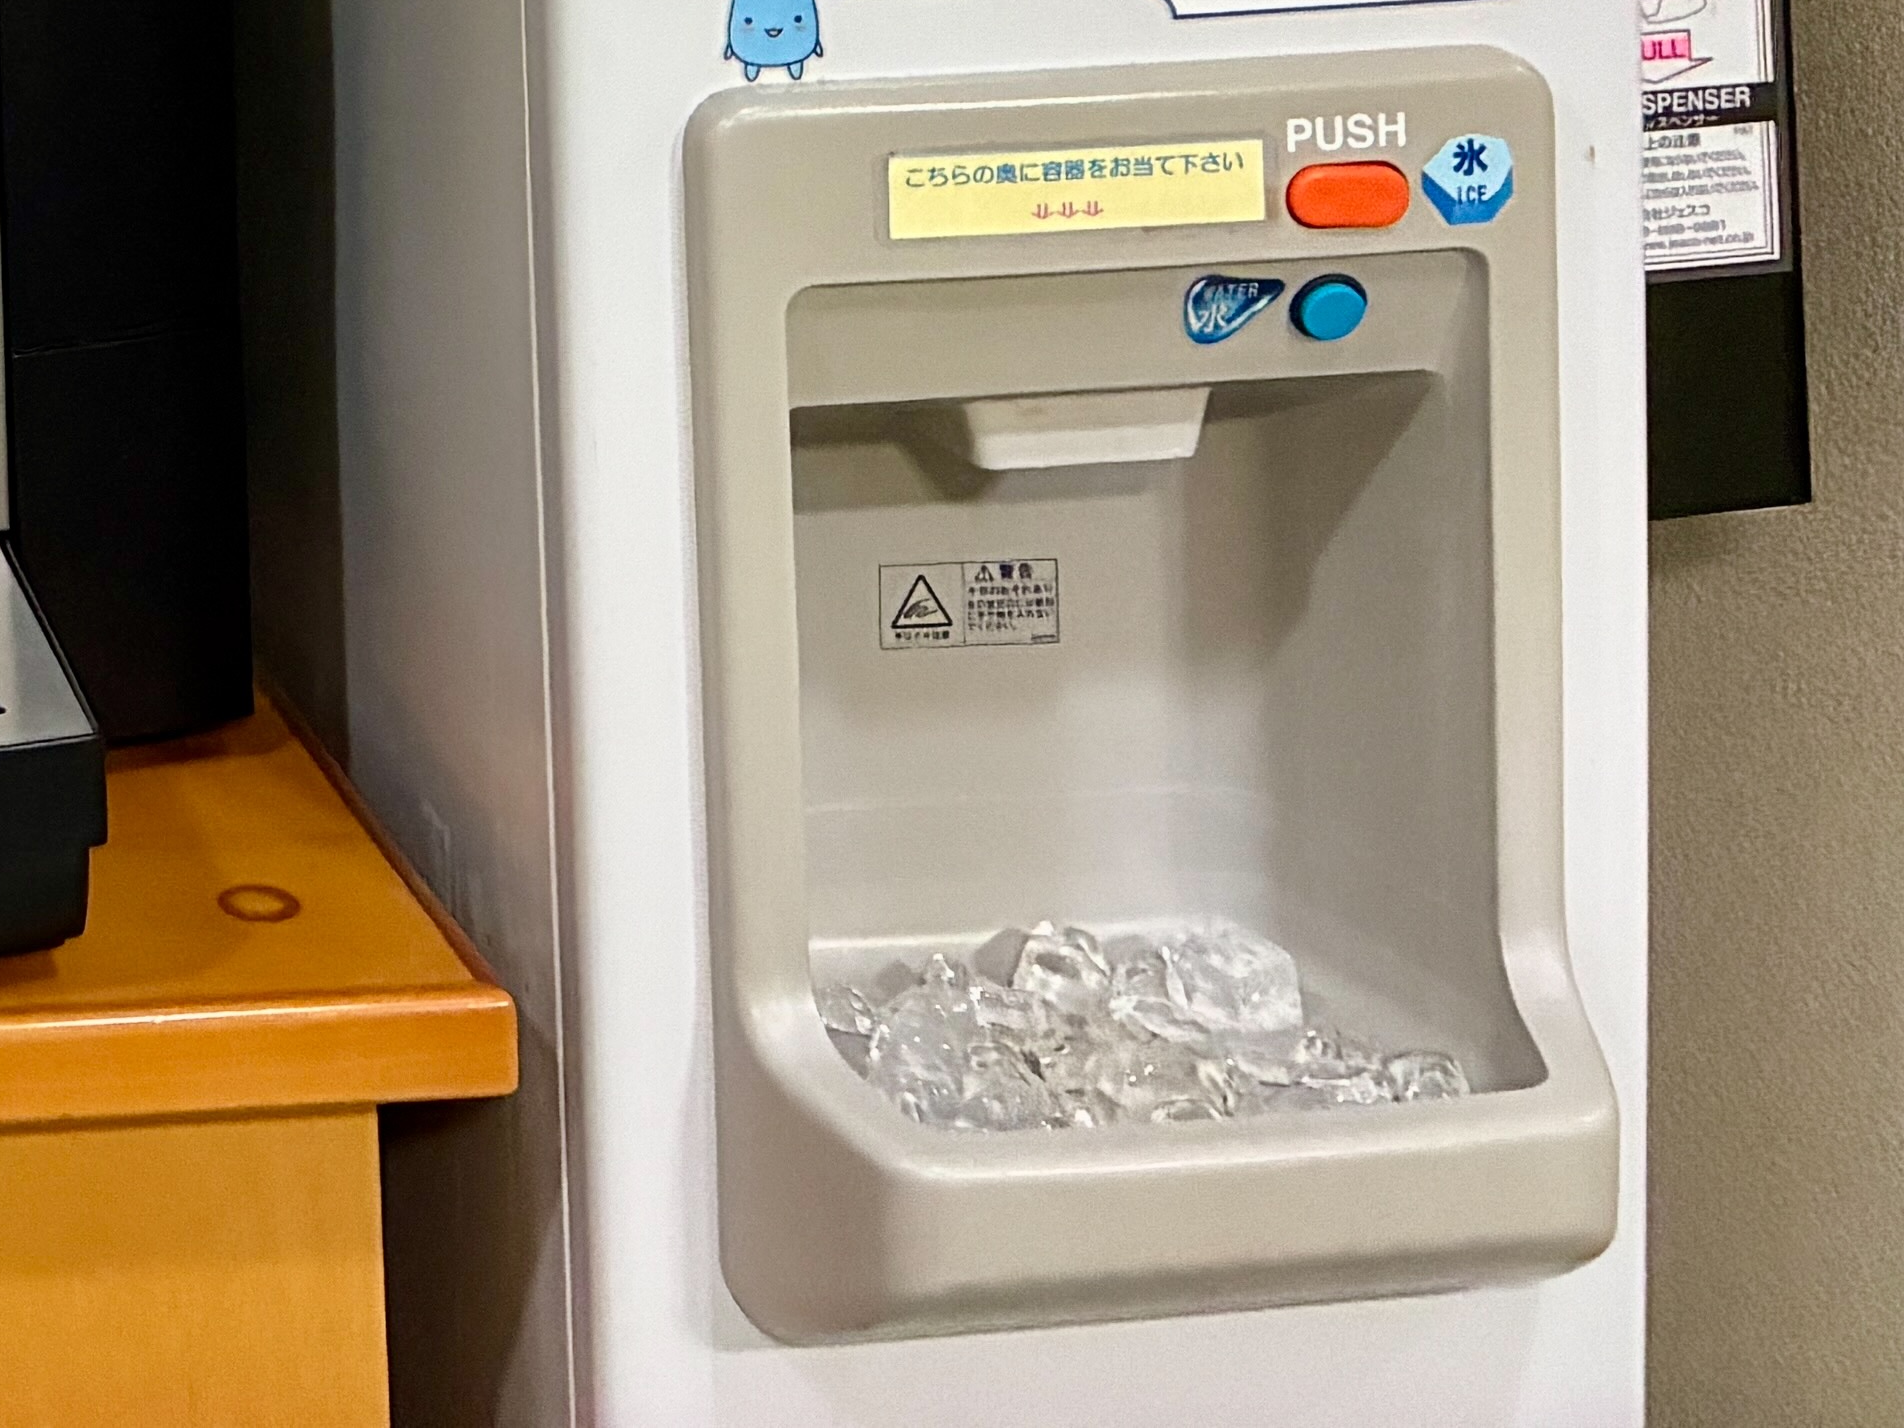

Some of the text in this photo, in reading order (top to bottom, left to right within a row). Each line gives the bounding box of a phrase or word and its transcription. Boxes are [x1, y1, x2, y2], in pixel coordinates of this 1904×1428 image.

[1642, 86, 1751, 115] SPENSER
[1286, 111, 1406, 153] PUSH
[903, 148, 1246, 190] こちらの奥に容器をお当て下さい
[1452, 138, 1489, 176] 氷
[1456, 184, 1488, 206] ICE
[1197, 303, 1228, 334] 水
